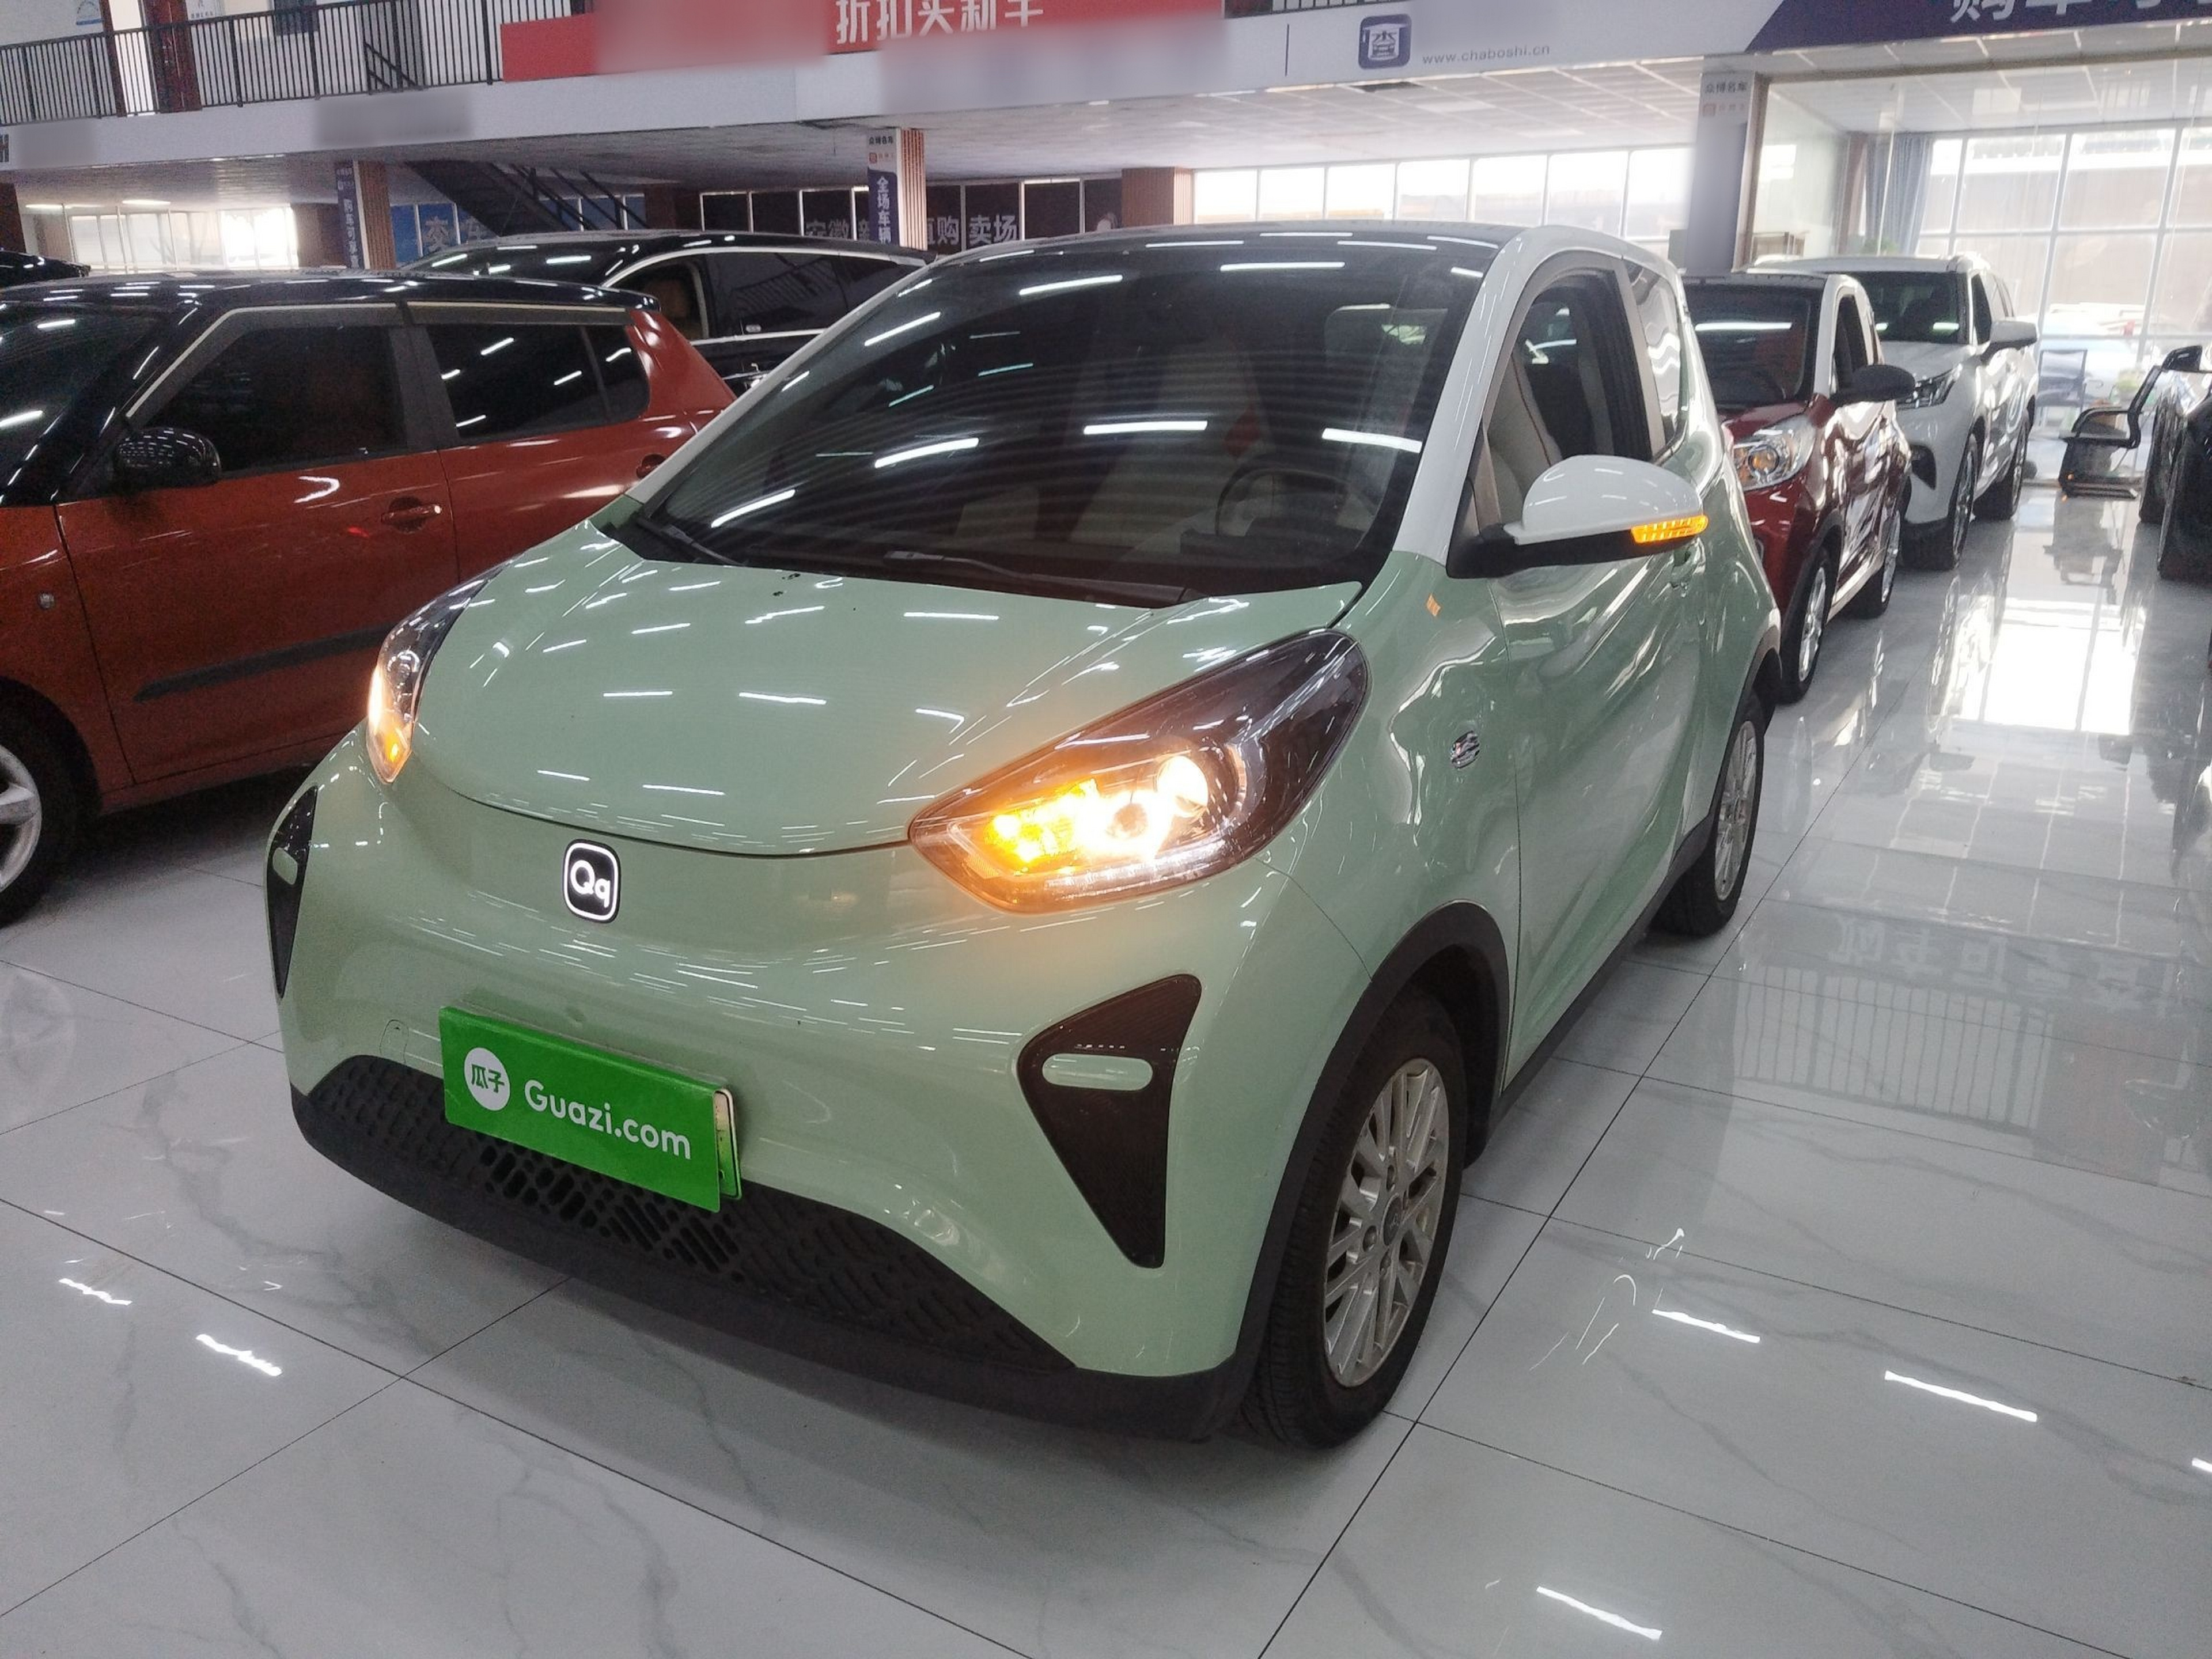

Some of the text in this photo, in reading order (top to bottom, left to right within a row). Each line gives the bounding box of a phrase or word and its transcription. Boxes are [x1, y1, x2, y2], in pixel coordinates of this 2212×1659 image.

[1422, 44, 1550, 65] www.chaboshi.cn
[877, 176, 891, 244] 全场车辆
[471, 1064, 505, 1093] 瓜子
[524, 1080, 691, 1160] Guazi.com
